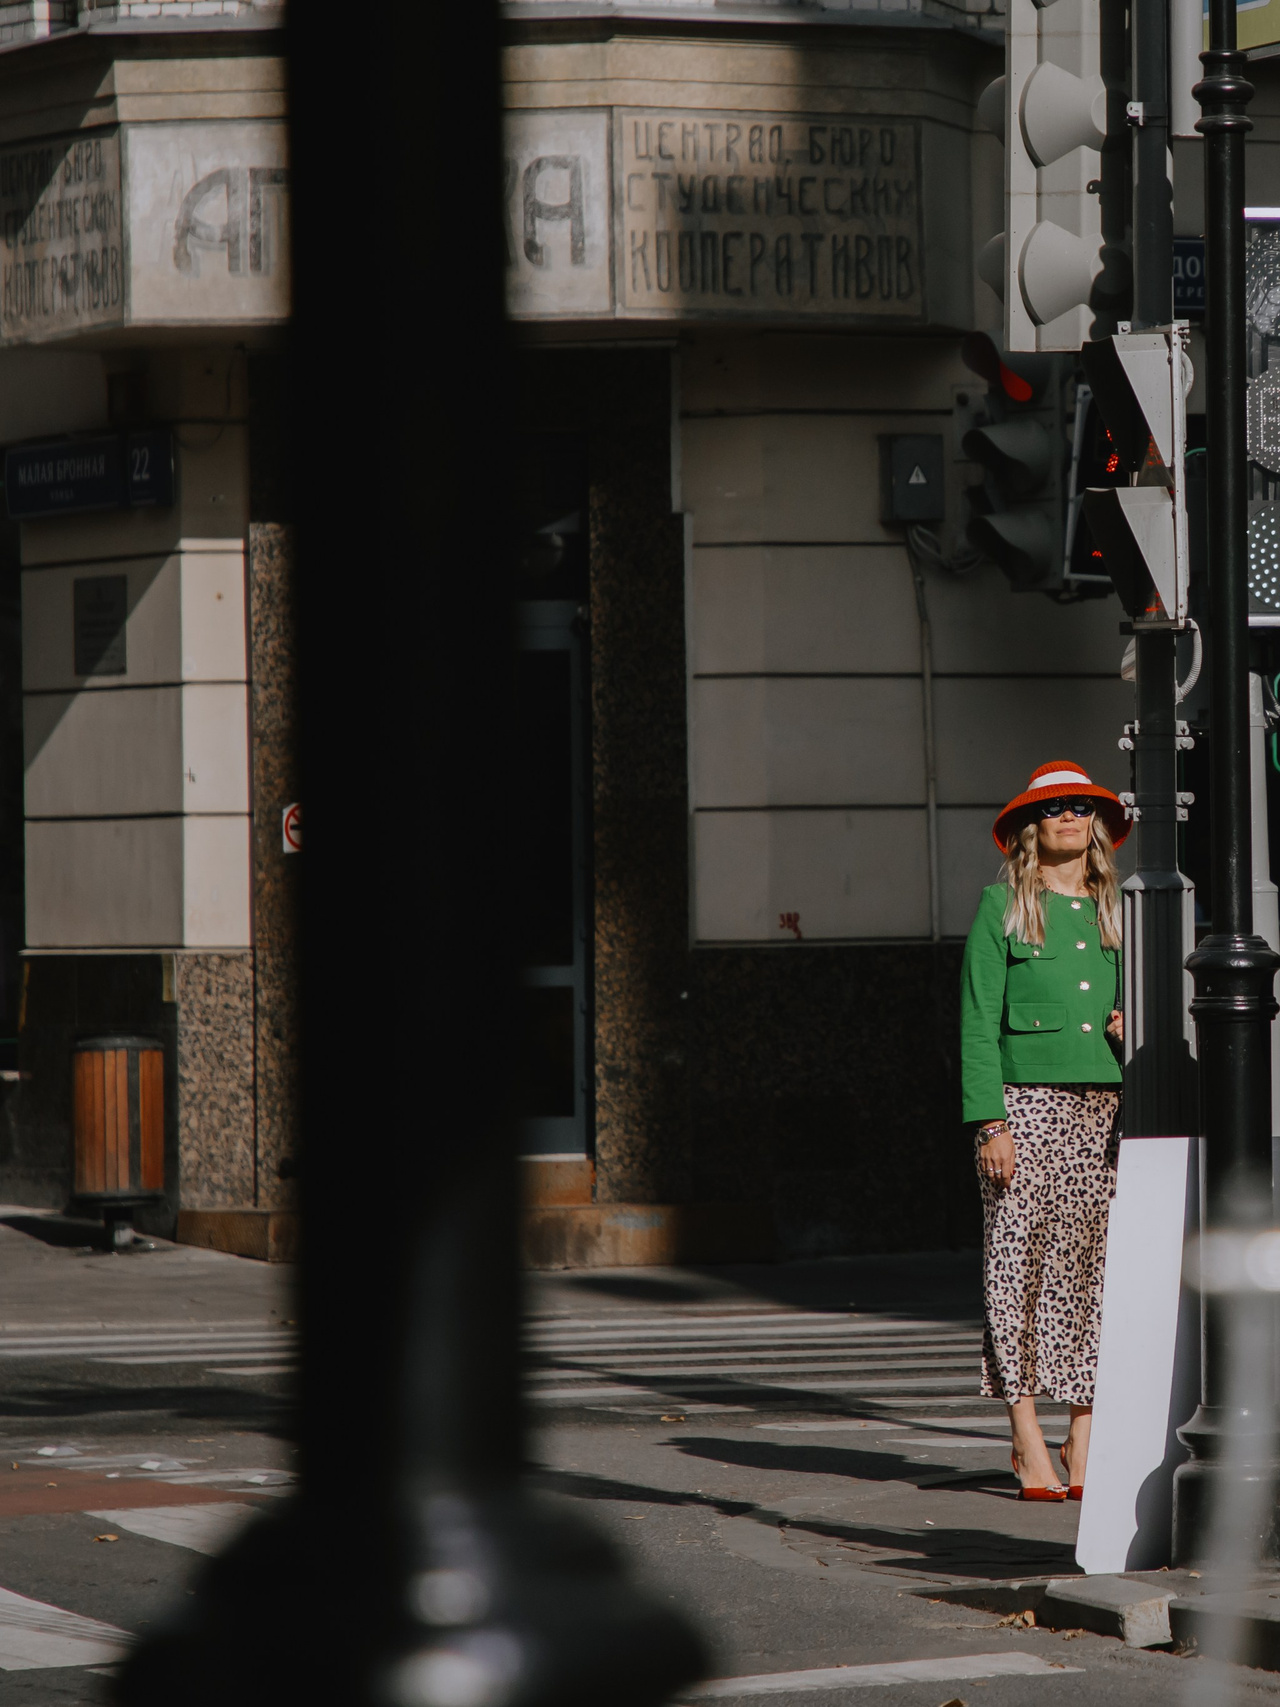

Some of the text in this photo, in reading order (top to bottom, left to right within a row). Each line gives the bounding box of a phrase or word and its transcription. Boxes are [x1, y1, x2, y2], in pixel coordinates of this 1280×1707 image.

[807, 125, 896, 167] БЮРО
[630, 230, 915, 300] КООПЕРАТИВОВ
[18, 454, 105, 488] МАЛАЯ БРОННАЯ
[131, 447, 150, 481] 22
